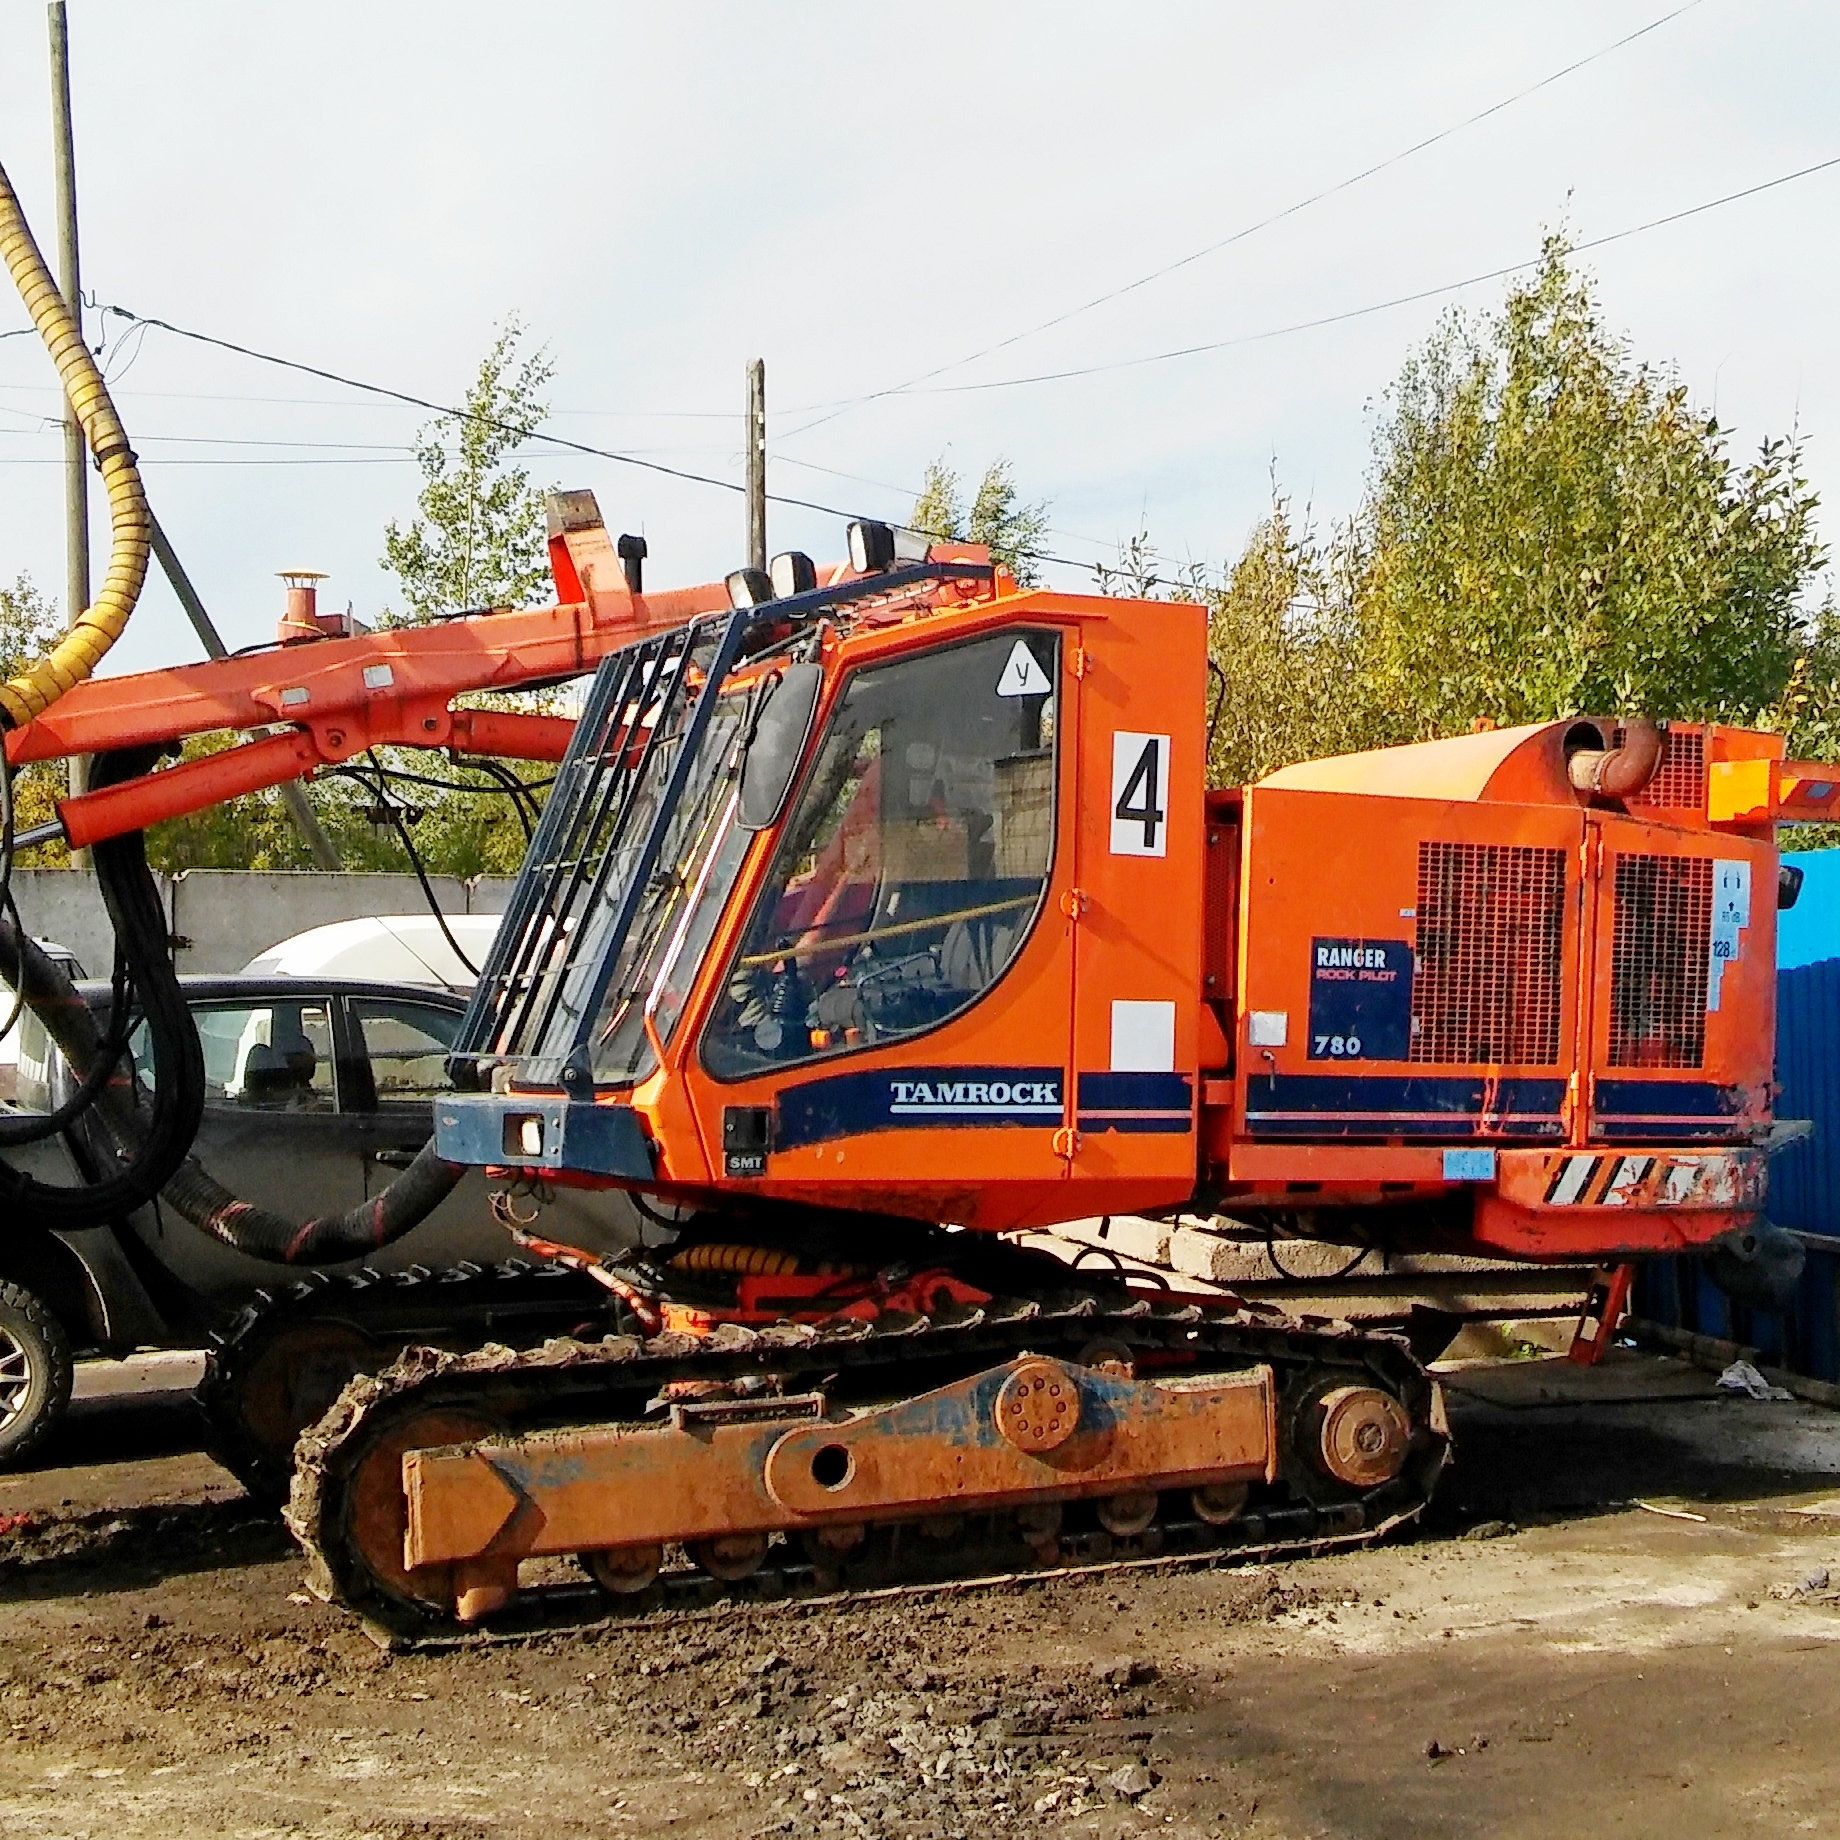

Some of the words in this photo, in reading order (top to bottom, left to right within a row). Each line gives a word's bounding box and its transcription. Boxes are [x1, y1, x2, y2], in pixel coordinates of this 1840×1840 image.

[1115, 738, 1163, 848] 4
[1317, 947, 1386, 968] RANGER
[1712, 940, 1731, 958] 128
[1316, 969, 1356, 980] ROCK
[1358, 970, 1398, 982] PILOT
[1314, 1035, 1362, 1055] 780
[890, 1082, 1058, 1104] TAMROCK
[729, 1156, 762, 1169] SMT
